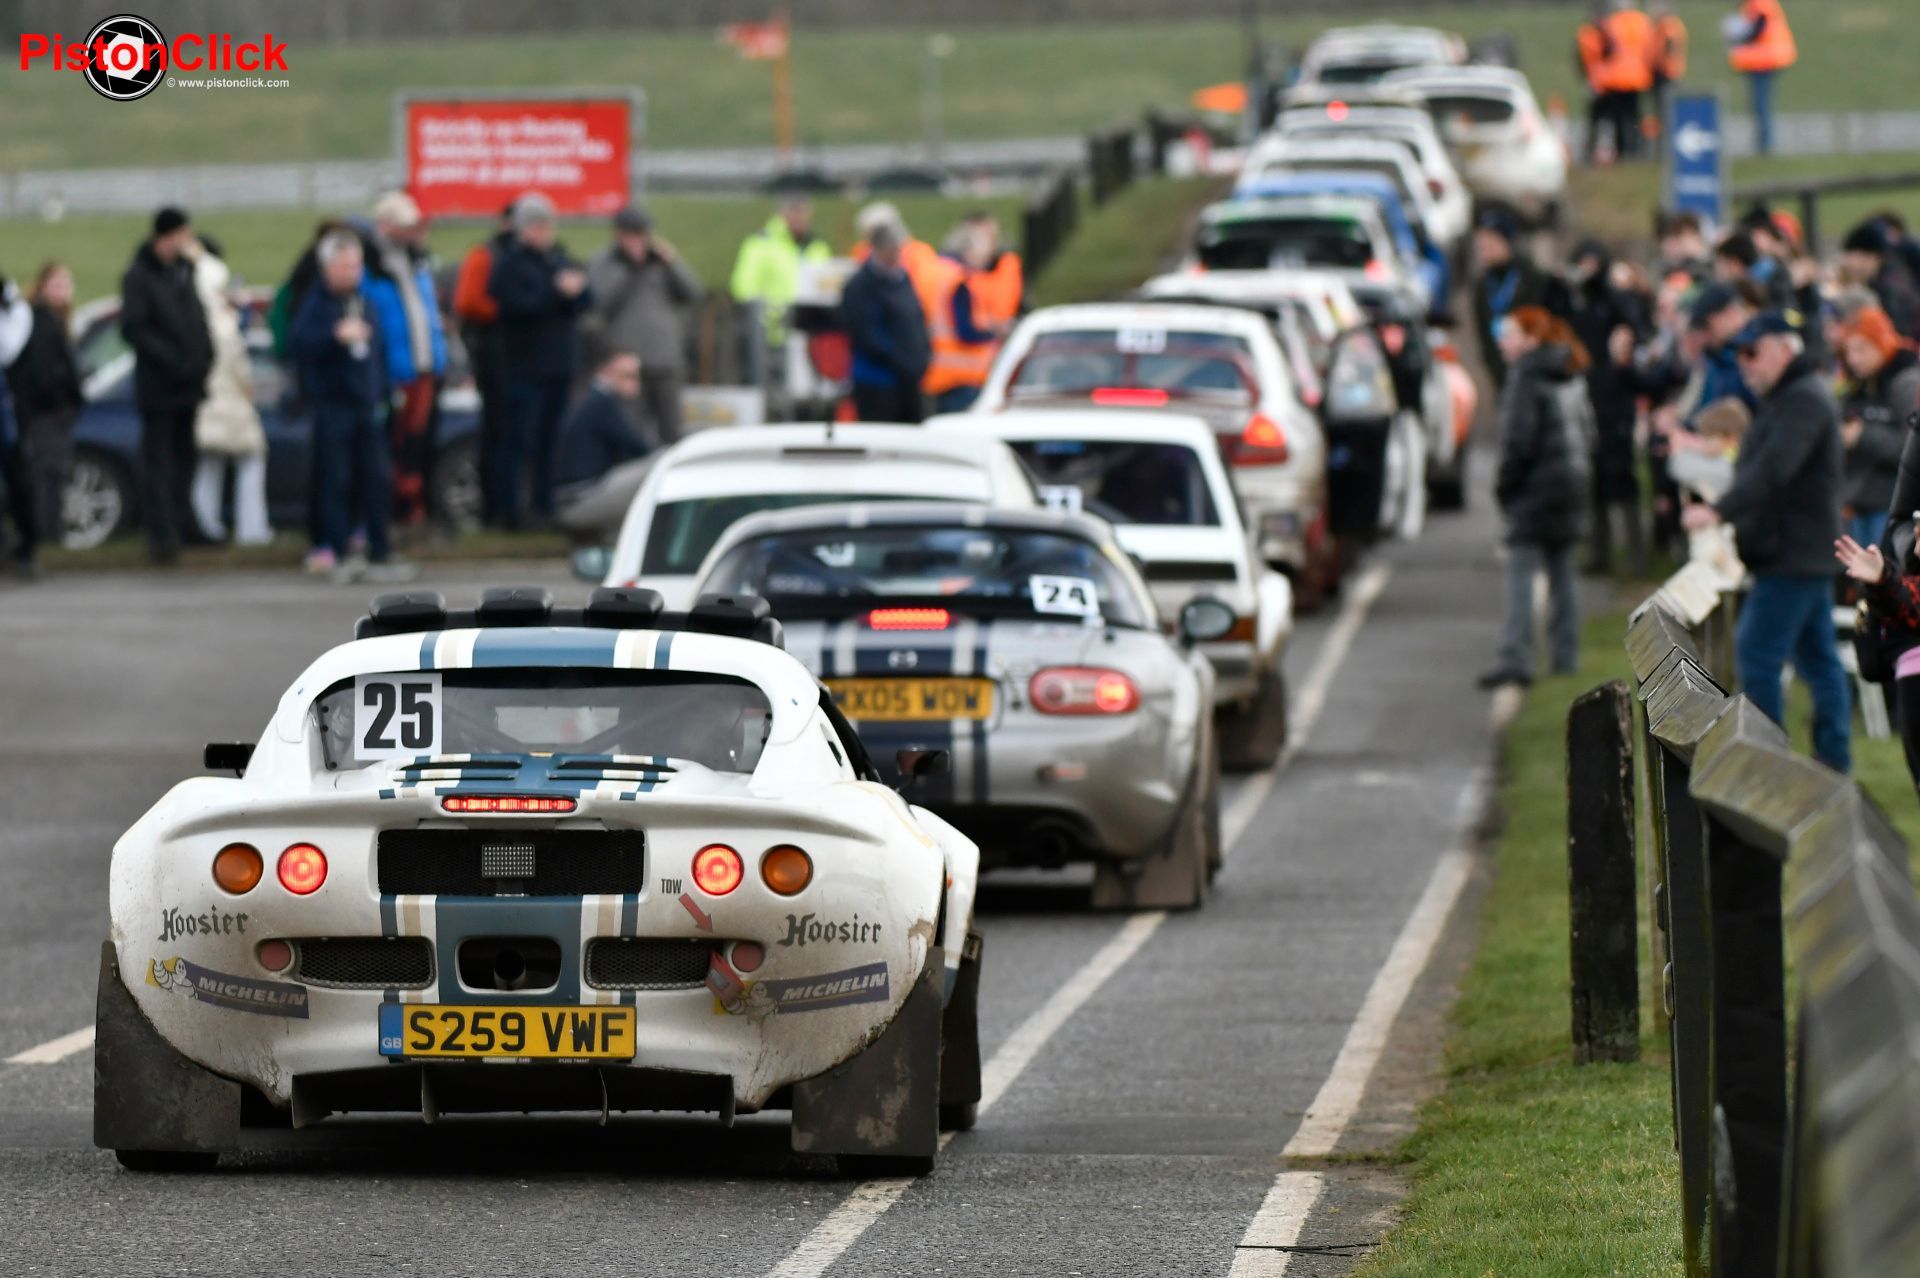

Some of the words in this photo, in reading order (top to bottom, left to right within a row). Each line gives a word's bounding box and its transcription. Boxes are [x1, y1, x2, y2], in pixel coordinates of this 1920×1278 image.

[363, 682, 434, 749] 25
[661, 878, 682, 894] TOW
[158, 904, 249, 942] Hoosier
[777, 912, 882, 947] Hoosier
[198, 976, 306, 1006] MICHELIN
[782, 971, 887, 1001] MICHELIN
[382, 1037, 402, 1049] GB
[410, 1010, 526, 1052] S259
[541, 1011, 627, 1053] VWF
